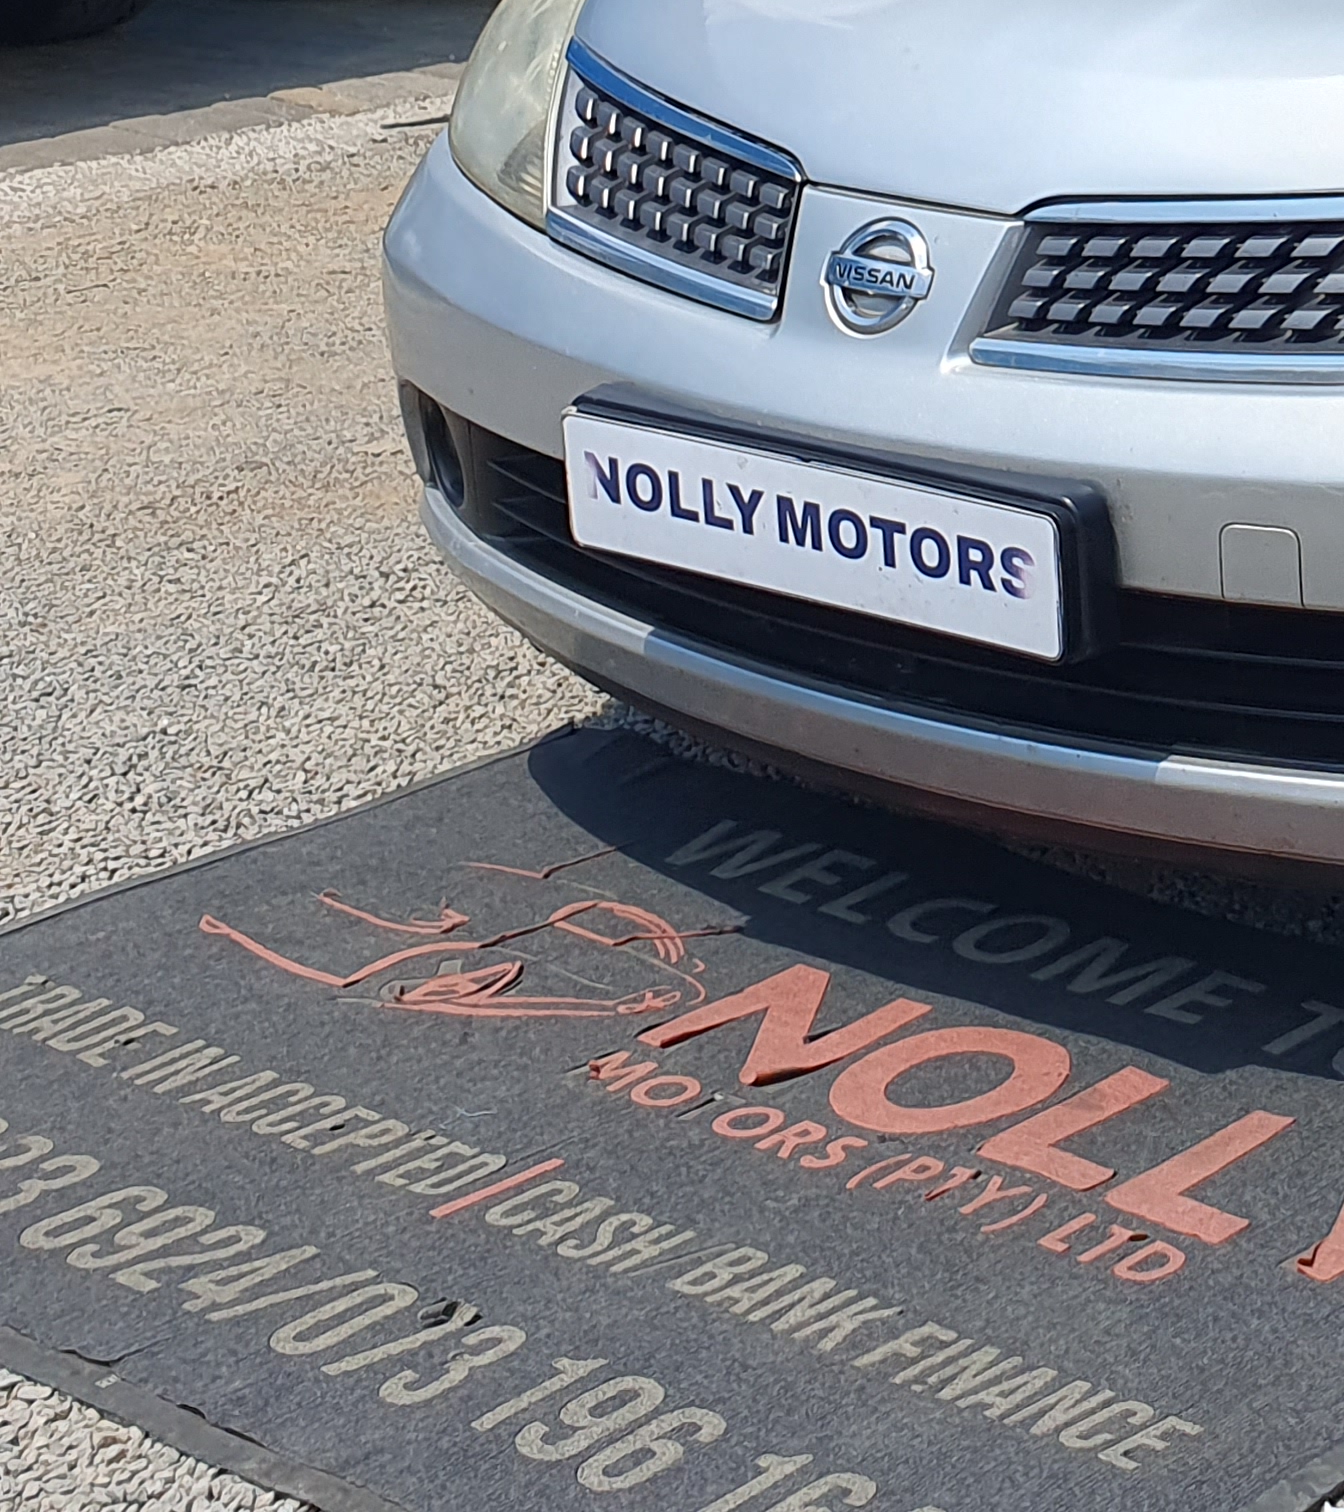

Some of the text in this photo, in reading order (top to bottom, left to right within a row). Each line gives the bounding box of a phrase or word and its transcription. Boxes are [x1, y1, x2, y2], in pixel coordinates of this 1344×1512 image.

[834, 263, 916, 291] NISSAN
[583, 450, 1036, 600] NOLLY MOTORS
[665, 819, 1267, 1025] WELCOME
[119, 1038, 242, 1094] IN
[851, 1320, 1204, 1471] FINANCE
[1037, 1212, 1187, 1282] LTD
[469, 1356, 728, 1492] 196
